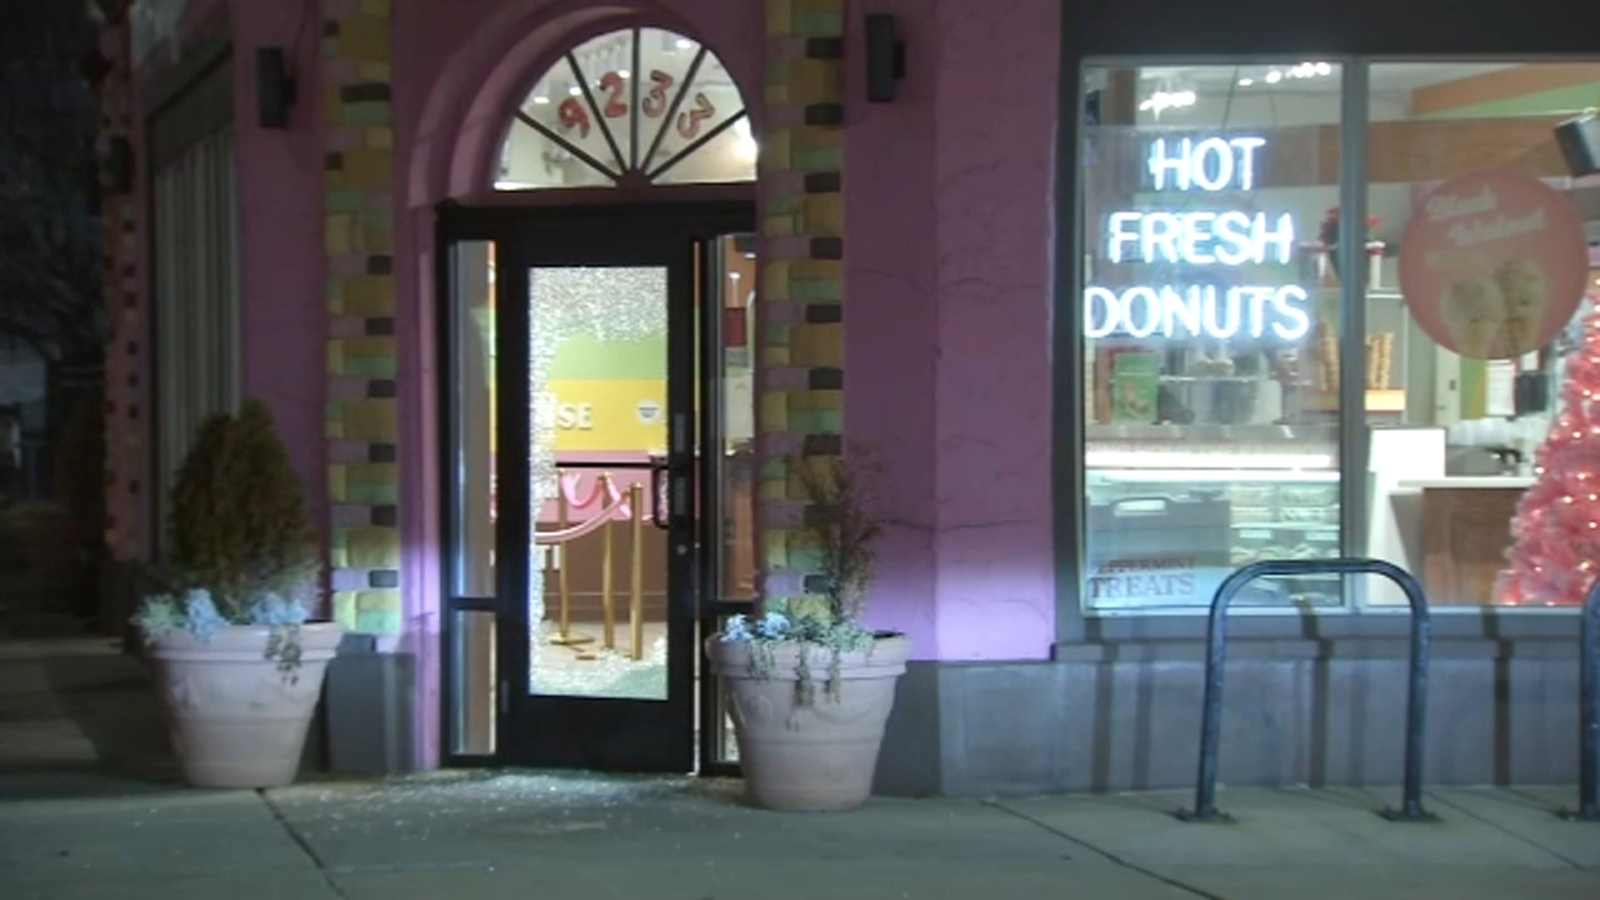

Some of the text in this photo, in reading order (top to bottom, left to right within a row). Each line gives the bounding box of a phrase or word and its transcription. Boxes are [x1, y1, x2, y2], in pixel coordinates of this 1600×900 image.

[1148, 137, 1266, 191] HOT
[1108, 211, 1293, 265] FRESH
[1084, 284, 1309, 340] DONUTS
[1089, 573, 1196, 599] TREATS
